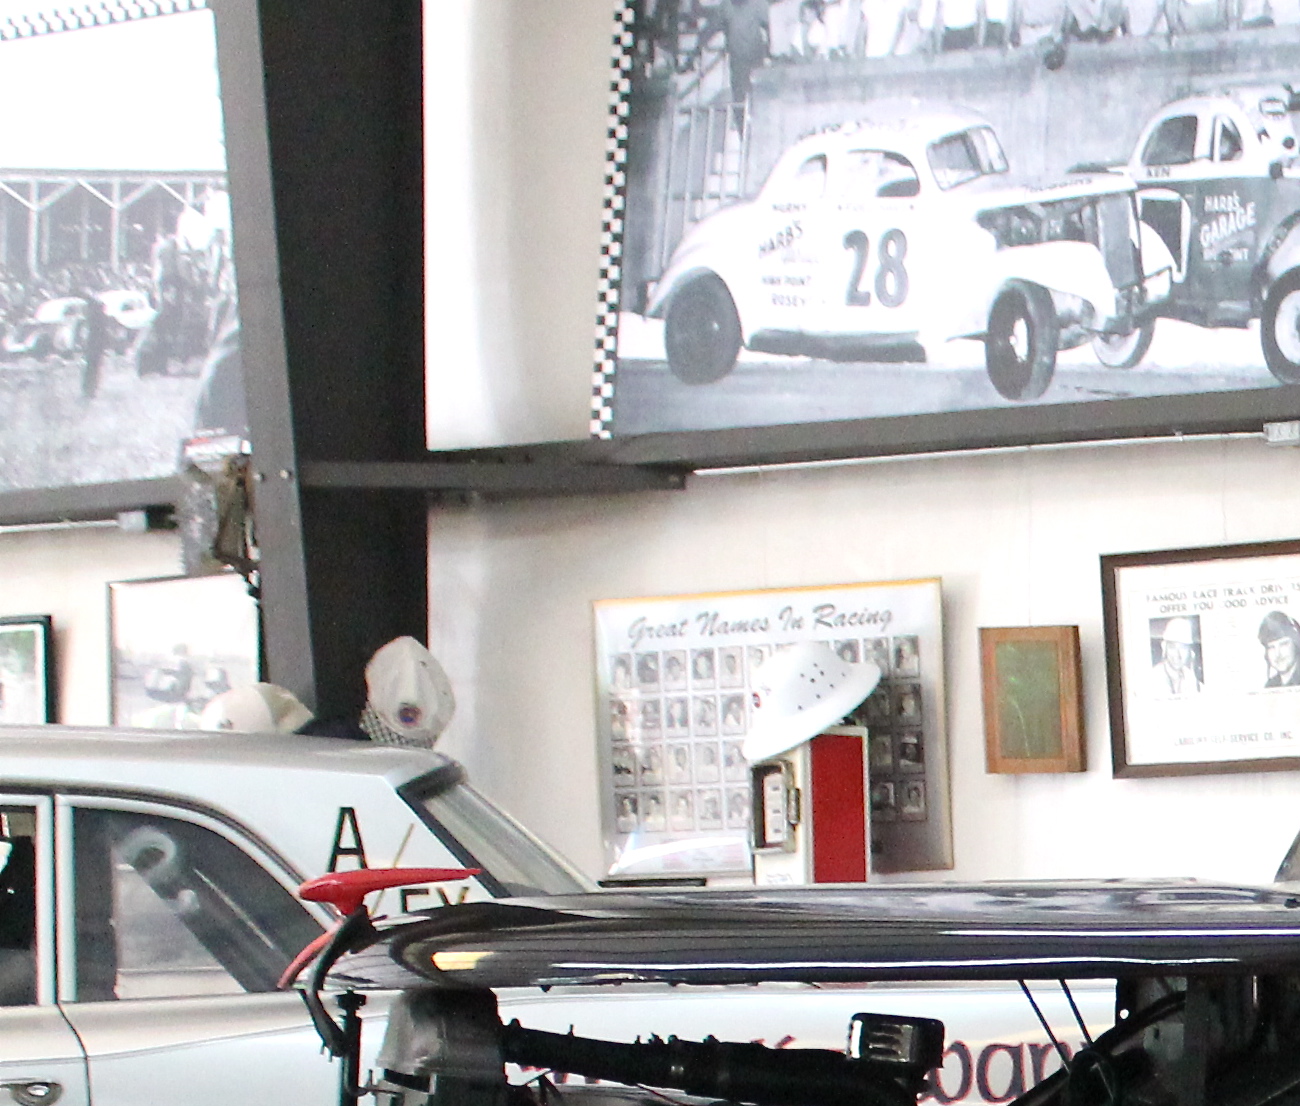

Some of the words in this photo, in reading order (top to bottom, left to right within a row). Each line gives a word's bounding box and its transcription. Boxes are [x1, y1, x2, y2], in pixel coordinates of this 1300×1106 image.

[1200, 201, 1257, 249] GARAGE
[842, 227, 909, 308] 28
[627, 616, 689, 649] Great
[695, 610, 771, 637] Names
[778, 605, 805, 631] In
[812, 602, 893, 633] Racing
[1159, 602, 1188, 614] OFFER
